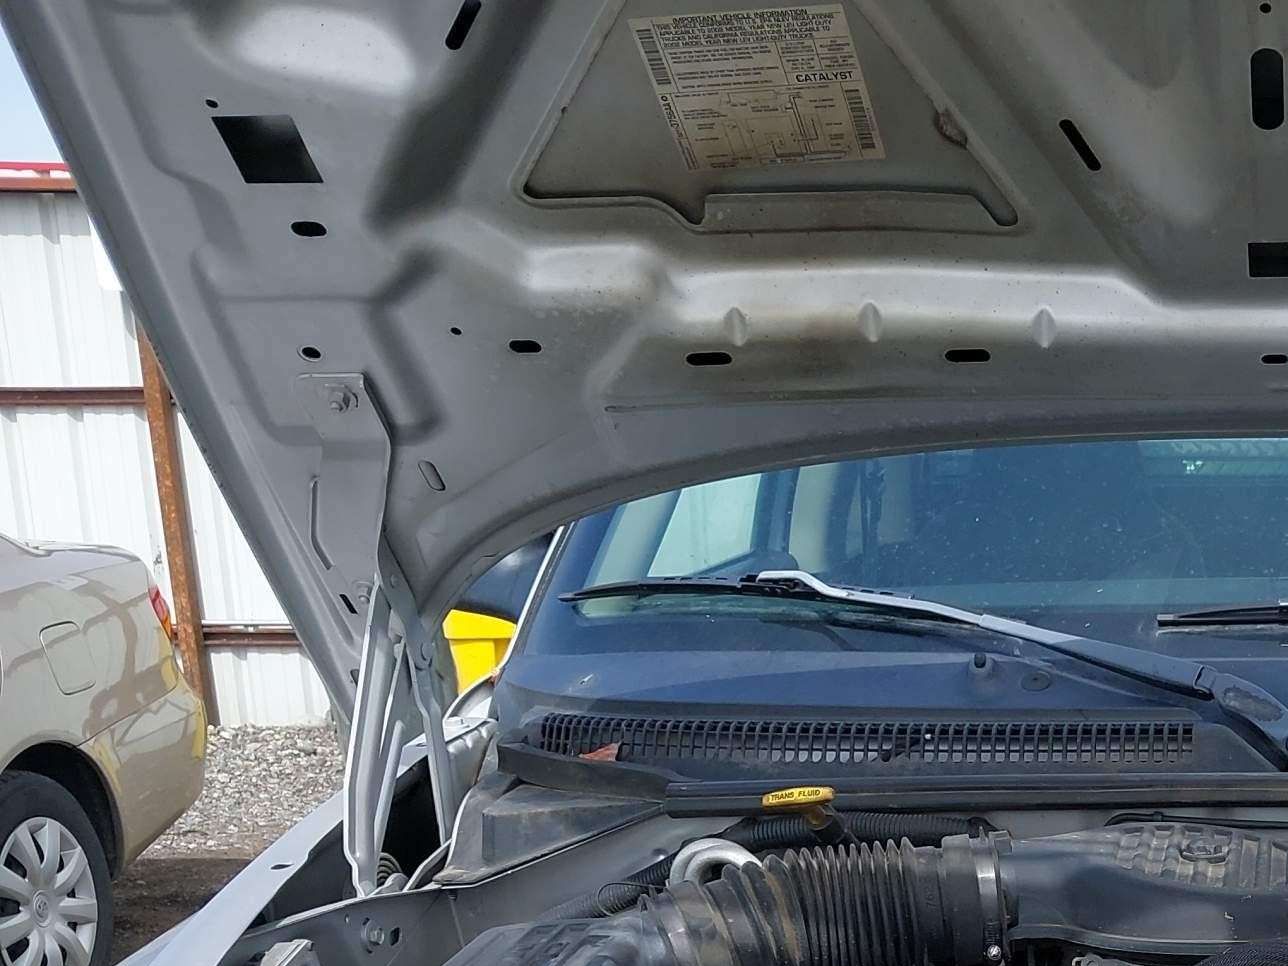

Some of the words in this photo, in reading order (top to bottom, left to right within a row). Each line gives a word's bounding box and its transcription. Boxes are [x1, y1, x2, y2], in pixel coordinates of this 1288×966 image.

[796, 70, 854, 83] CATALYST
[771, 792, 794, 802] TRANS
[798, 790, 820, 798] FLUID
